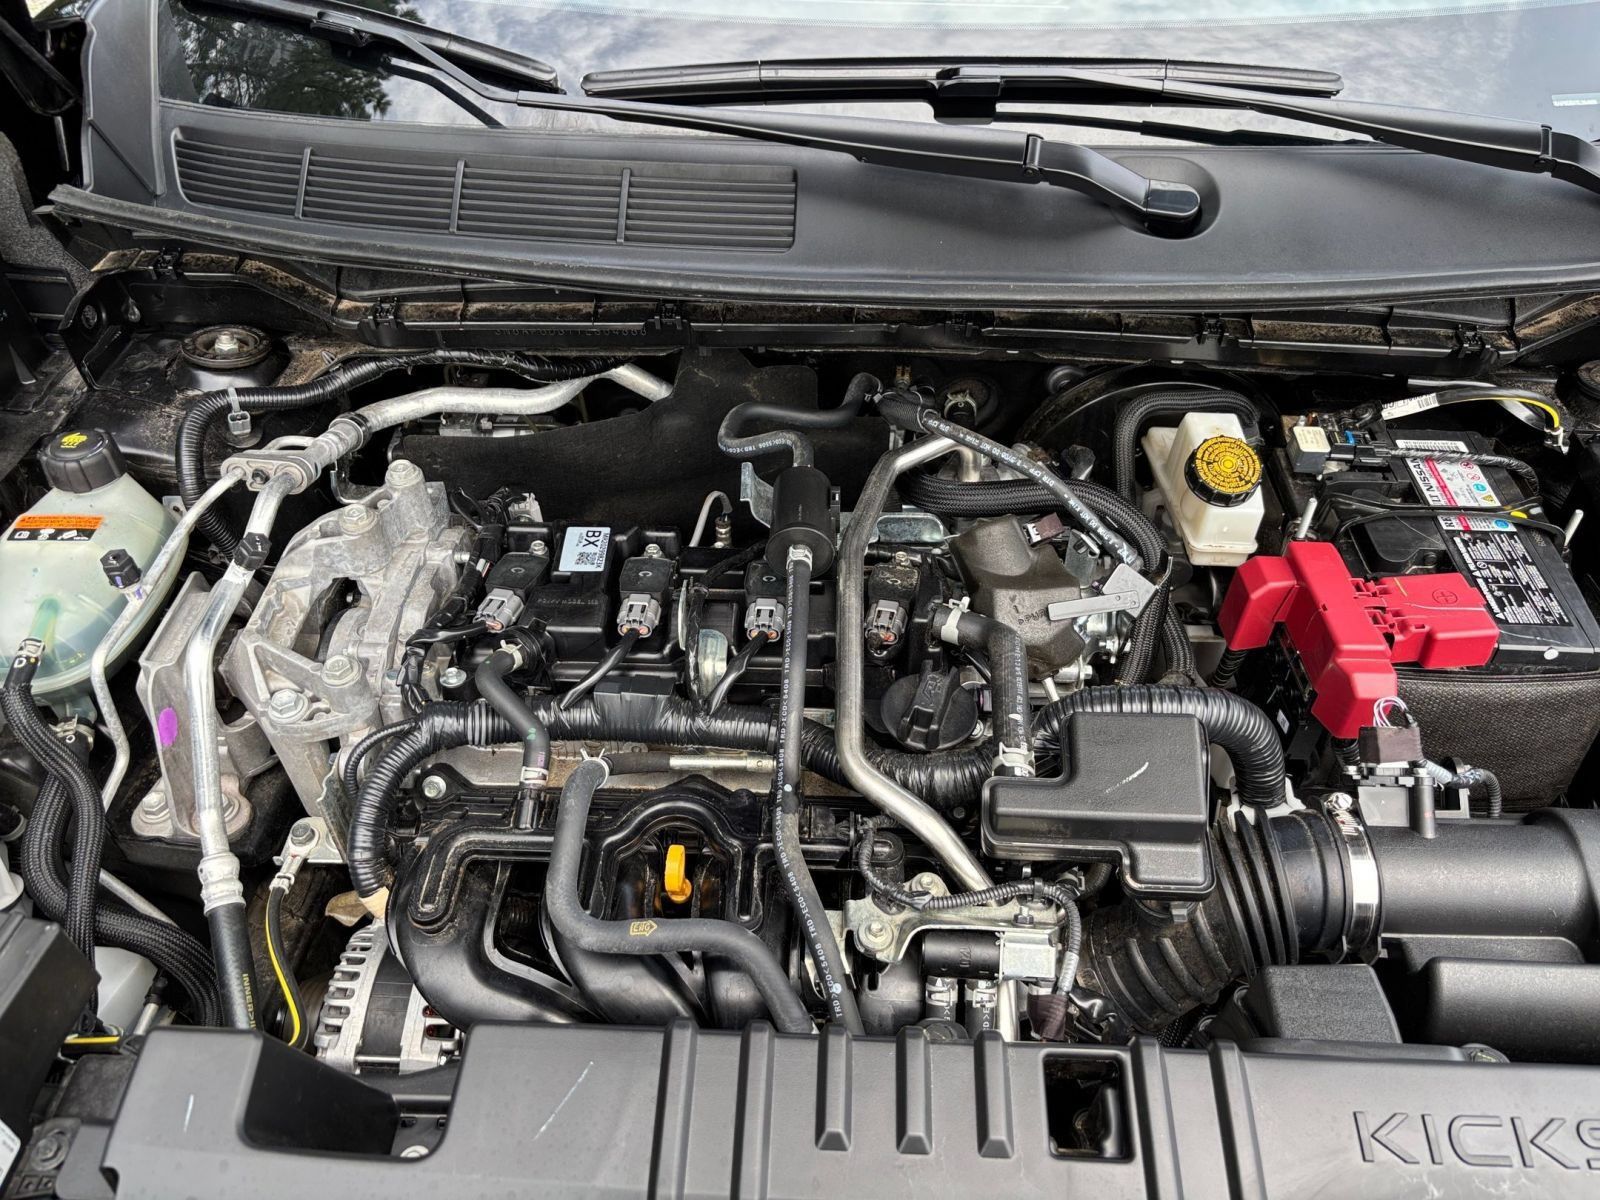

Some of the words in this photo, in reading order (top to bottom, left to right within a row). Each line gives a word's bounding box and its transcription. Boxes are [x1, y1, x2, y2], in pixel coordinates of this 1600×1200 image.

[582, 530, 602, 548] BX
[14, 657, 24, 668] D
[634, 923, 650, 932] ENG
